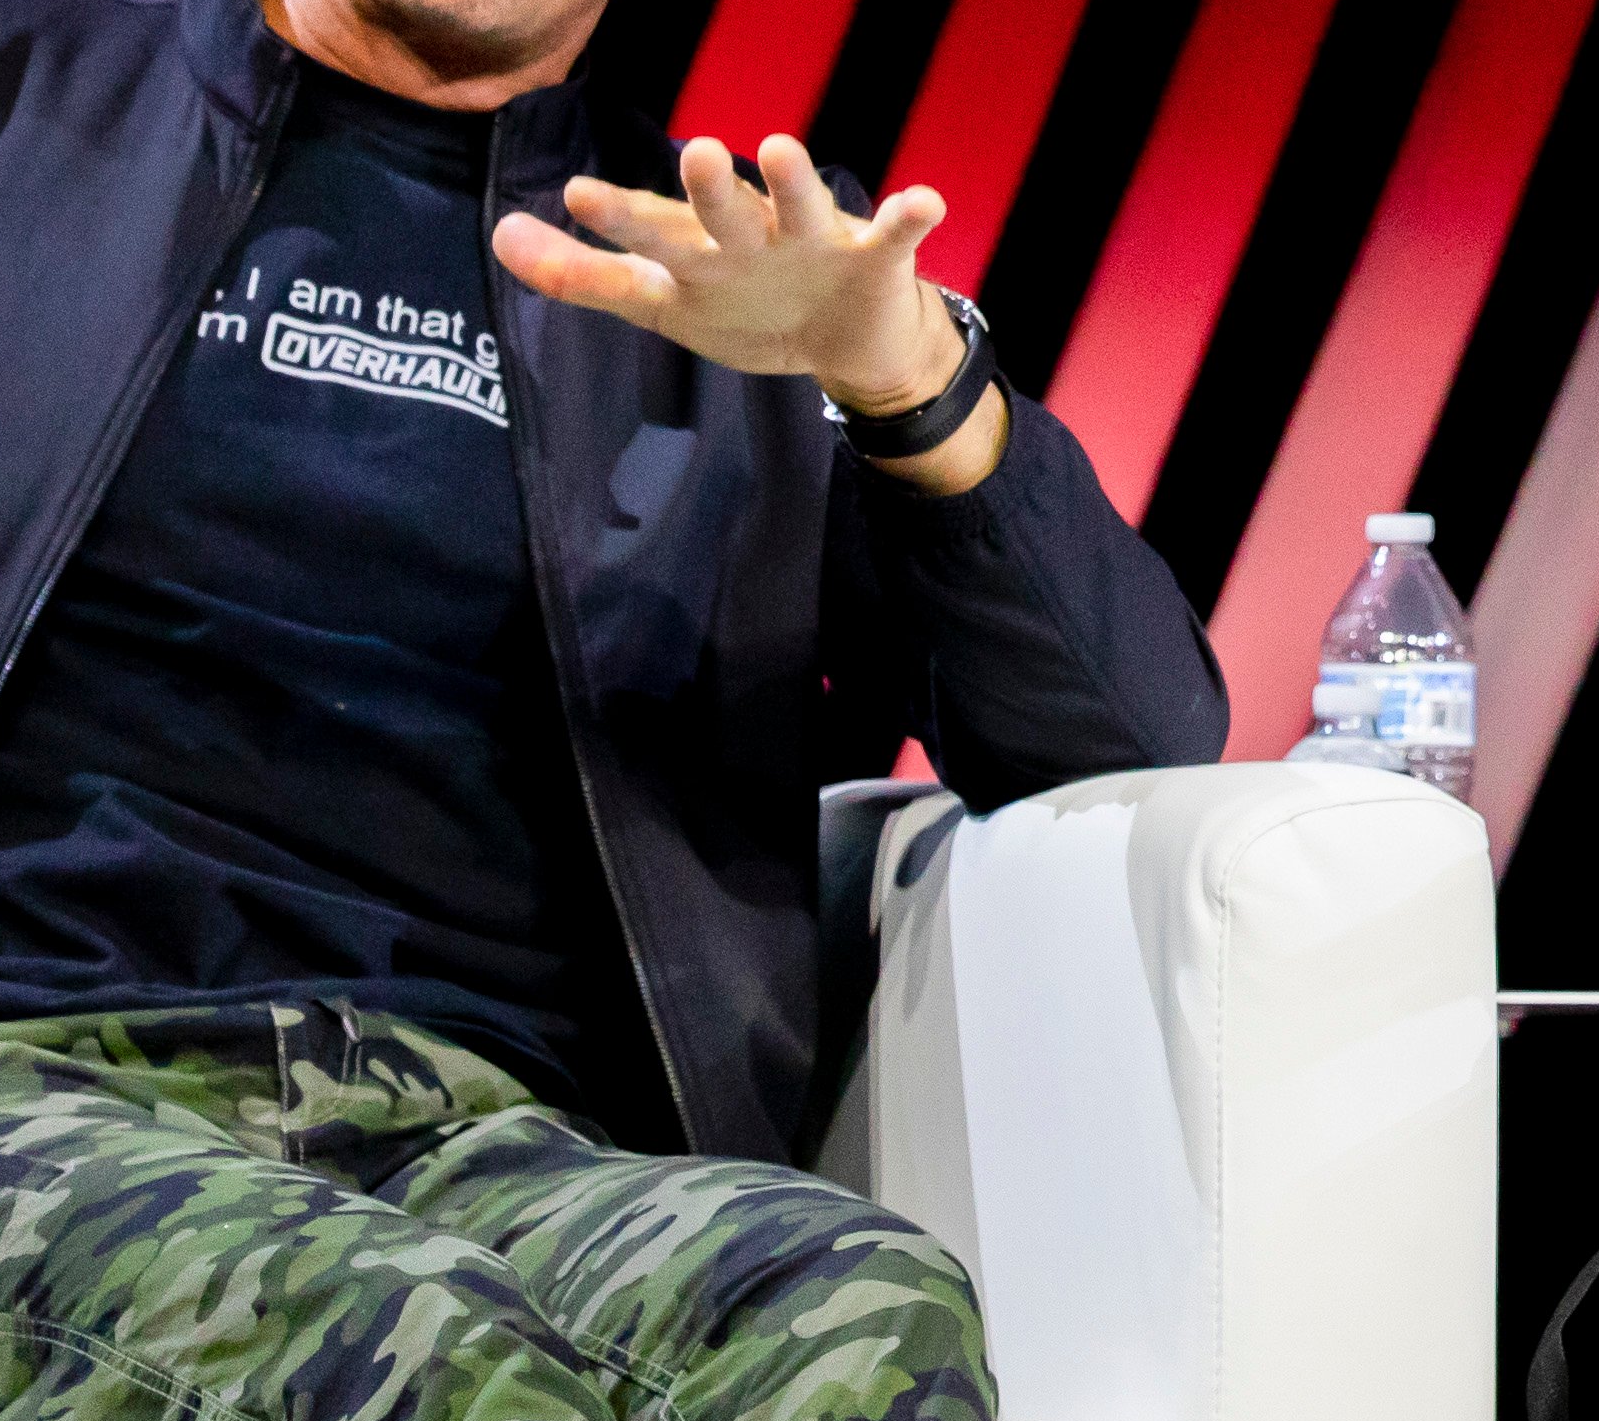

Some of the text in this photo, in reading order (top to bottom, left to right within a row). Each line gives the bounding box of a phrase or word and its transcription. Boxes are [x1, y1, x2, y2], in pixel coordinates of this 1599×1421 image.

[246, 267, 261, 301] I
[288, 278, 362, 320] am
[376, 295, 466, 346] that
